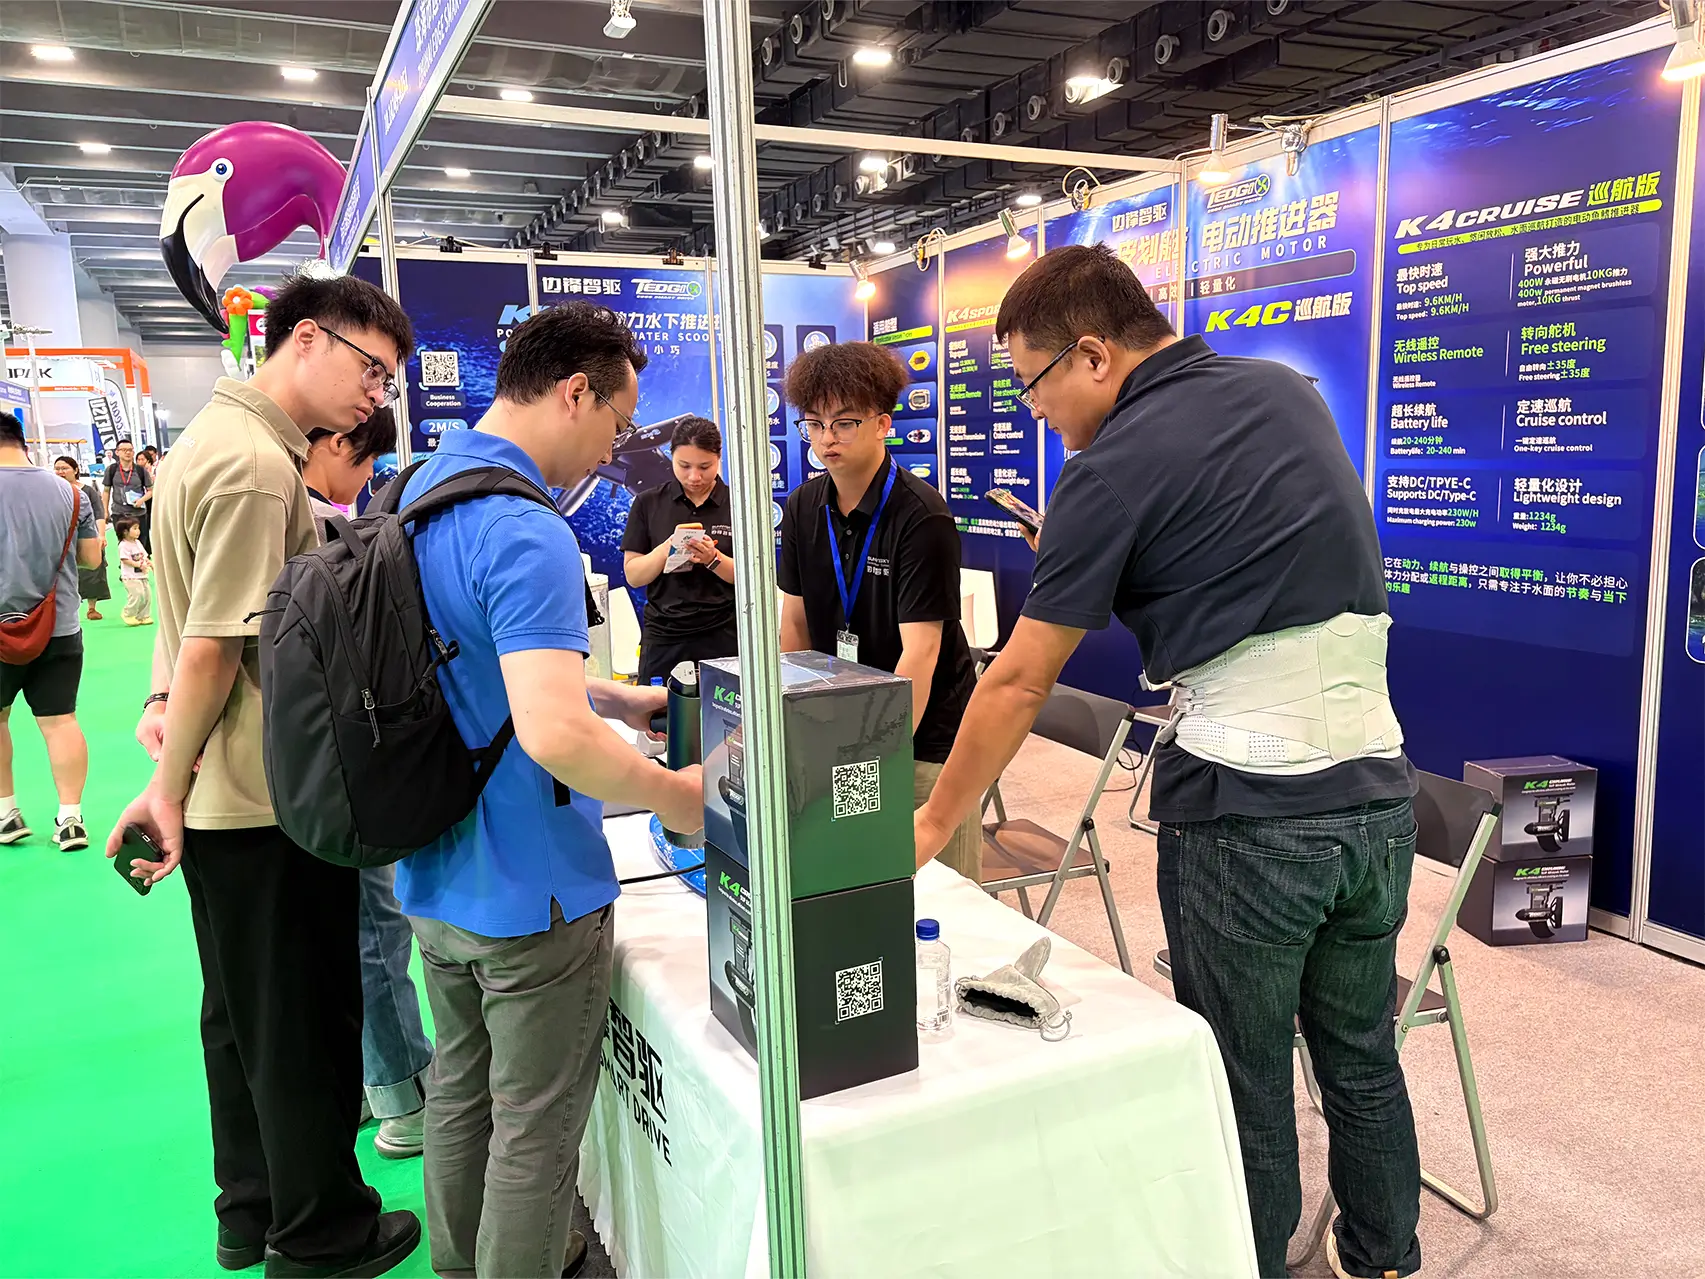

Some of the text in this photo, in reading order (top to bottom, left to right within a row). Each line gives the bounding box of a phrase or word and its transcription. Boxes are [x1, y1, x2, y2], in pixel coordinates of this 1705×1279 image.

[1587, 171, 1661, 206] 巡航版
[1202, 191, 1339, 253] 电动推进器
[1261, 235, 1327, 260] MOTOR
[1524, 240, 1580, 262] 强大推力
[1396, 262, 1443, 282] 最快时速
[1524, 254, 1588, 276] Powerful
[1200, 276, 1236, 295] 轻量化
[1397, 275, 1449, 295] Top speed
[1518, 277, 1543, 288] 400W
[1544, 286, 1577, 296] permanent
[1577, 284, 1601, 292] magnet
[1601, 279, 1632, 289] brushless
[1424, 293, 1463, 307] 9.6KM/H
[1562, 294, 1581, 302] thrust
[1204, 292, 1353, 333] K4C 巡航版
[1396, 313, 1408, 321] Top
[1431, 303, 1469, 316] 9.6KM/H
[1521, 322, 1577, 341] 转向舵机
[1394, 336, 1440, 353] 无线遥控
[1521, 336, 1607, 355] Free steering
[1393, 346, 1484, 364] Wireless Remote
[1392, 380, 1436, 389] Wireless Remote
[1518, 373, 1533, 382] Free
[426, 400, 462, 408] Cooperation
[1391, 403, 1436, 417] 超长续航
[1516, 397, 1572, 414] 定速巡航
[1390, 416, 1449, 431] Battery life
[1516, 411, 1607, 427] Cruise control
[1426, 446, 1452, 455] 20-240
[1452, 447, 1466, 455] min
[1513, 444, 1593, 453] One-key cruise control
[1387, 475, 1471, 490] 支持DC/TPYE-C
[1514, 477, 1582, 493] 轻量化设计
[1387, 489, 1476, 502] Supports DC/Type-C
[1513, 491, 1622, 508] Lightweight design
[1386, 516, 1412, 524] Maximum
[1412, 518, 1435, 527] charging
[1541, 522, 1566, 534] 1234g
[713, 685, 736, 706] K4
[1523, 780, 1549, 789] K4
[1515, 867, 1541, 876] K4
[719, 871, 741, 897] K4
[602, 997, 667, 1124] 智驱
[633, 1093, 672, 1167] DRIVE
